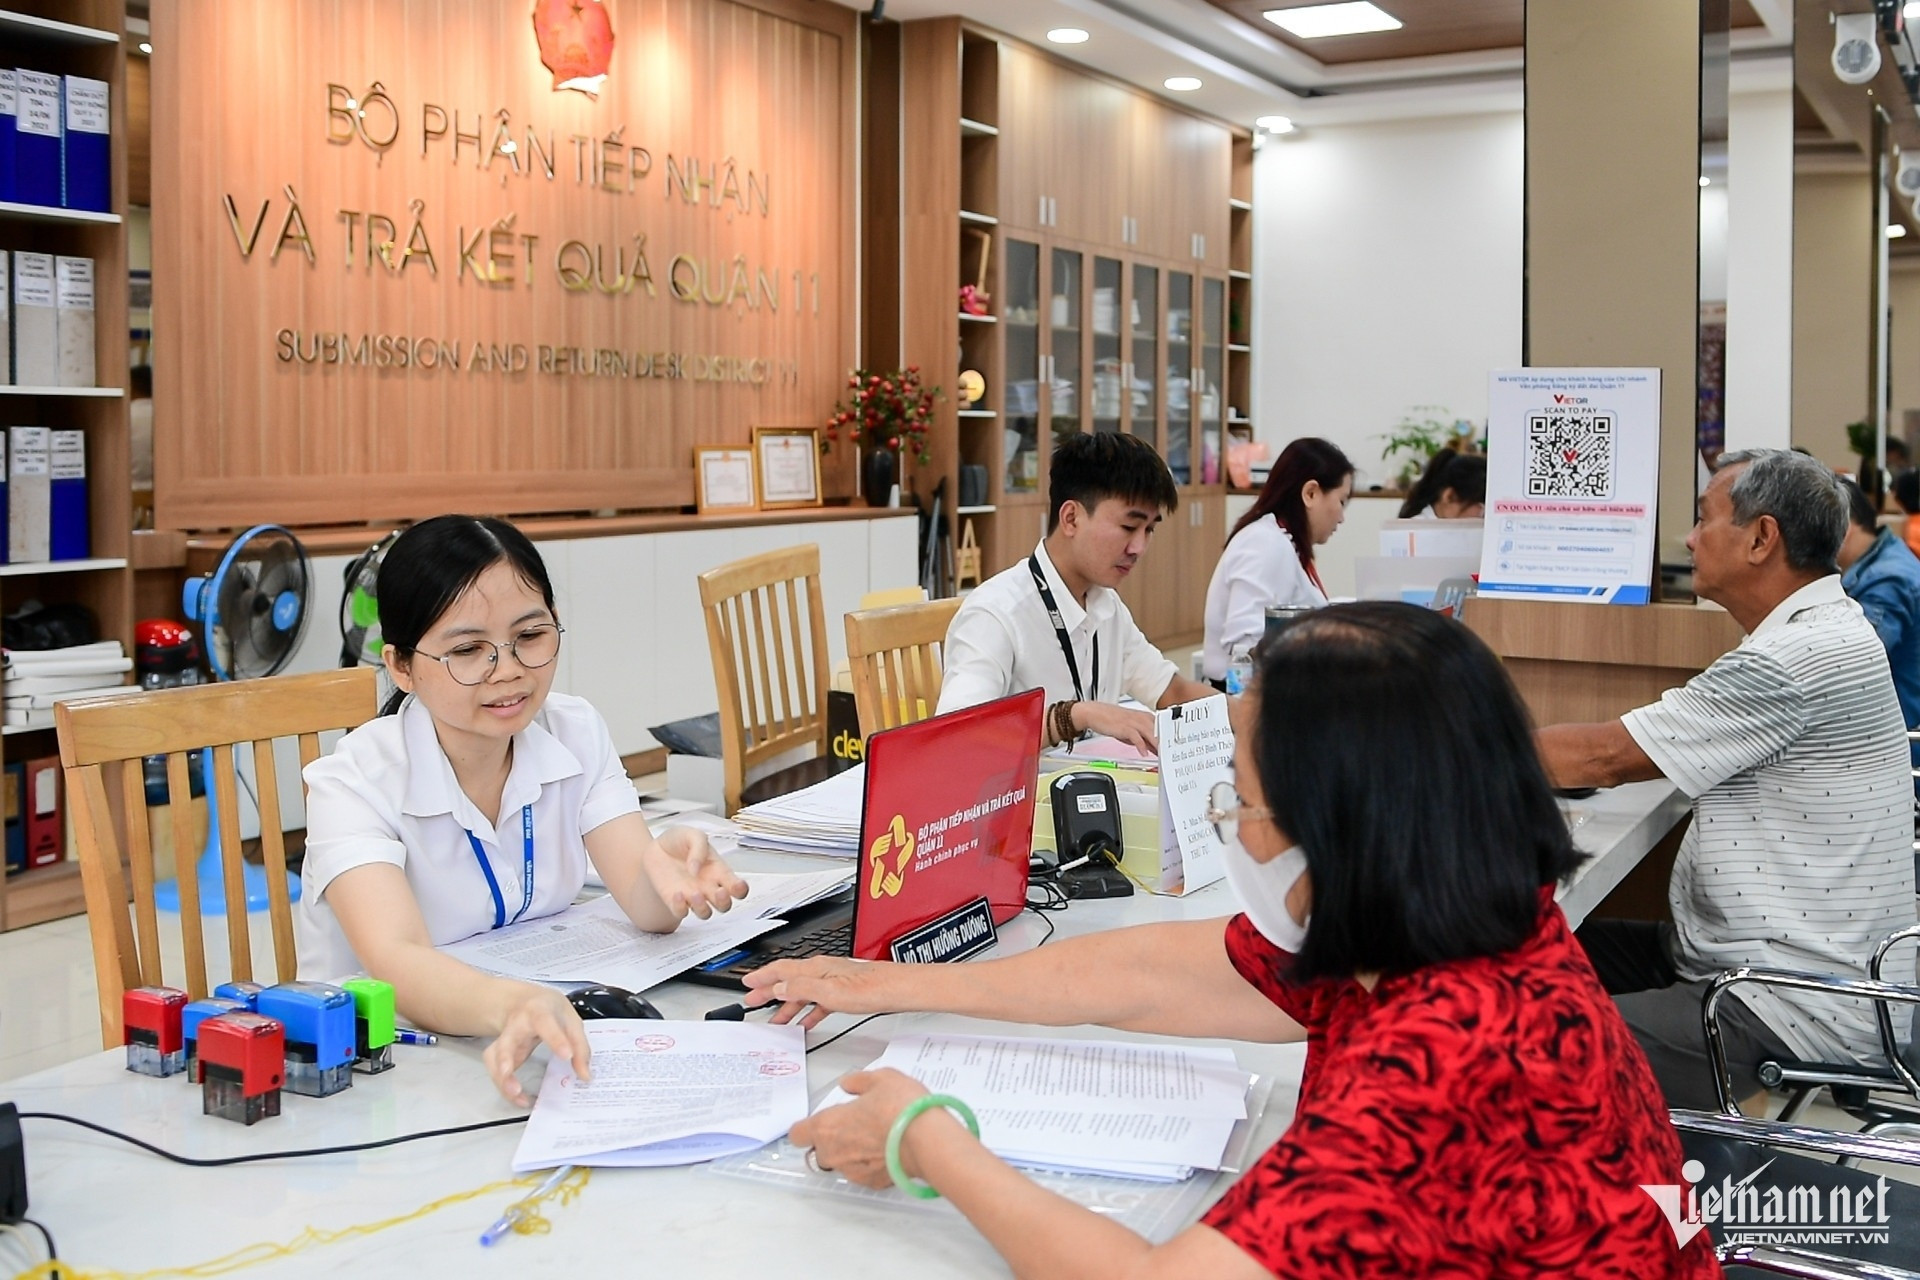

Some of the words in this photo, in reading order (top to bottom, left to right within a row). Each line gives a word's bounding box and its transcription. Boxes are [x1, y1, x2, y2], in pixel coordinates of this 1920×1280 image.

[325, 81, 399, 168] BỘ
[421, 103, 554, 188] PHẬN
[570, 125, 652, 194] TIẾP
[664, 153, 769, 223] NHẬN
[222, 184, 316, 265] VÀ
[337, 198, 438, 275] TRẢ
[457, 212, 539, 285] KẾT
[556, 232, 656, 298] QUẢ
[667, 253, 778, 325] QUẬN
[793, 270, 820, 315] 11
[276, 328, 460, 370] SUBMISSION
[466, 341, 529, 373] AND
[537, 344, 629, 378] RETURN
[634, 352, 688, 380] DESK
[694, 355, 775, 384] DISTRICT
[781, 359, 798, 387] 11
[1544, 407, 1566, 415] SCAN
[1568, 407, 1579, 415] TO
[918, 822, 929, 842] BỘ
[929, 817, 949, 838] PHẬN
[948, 809, 963, 829] TIẾP
[963, 804, 981, 822] NHẬN
[981, 799, 990, 815] VÀ
[990, 794, 1001, 812] TRẢ
[1001, 790, 1014, 808] KẾT
[1014, 785, 1026, 805] QUẢ
[915, 857, 932, 872] Hành
[933, 848, 952, 864] chính
[953, 841, 970, 857] phục
[970, 838, 979, 849] vụ
[916, 837, 936, 859] QUẬN
[959, 913, 988, 943] DƯƠNG
